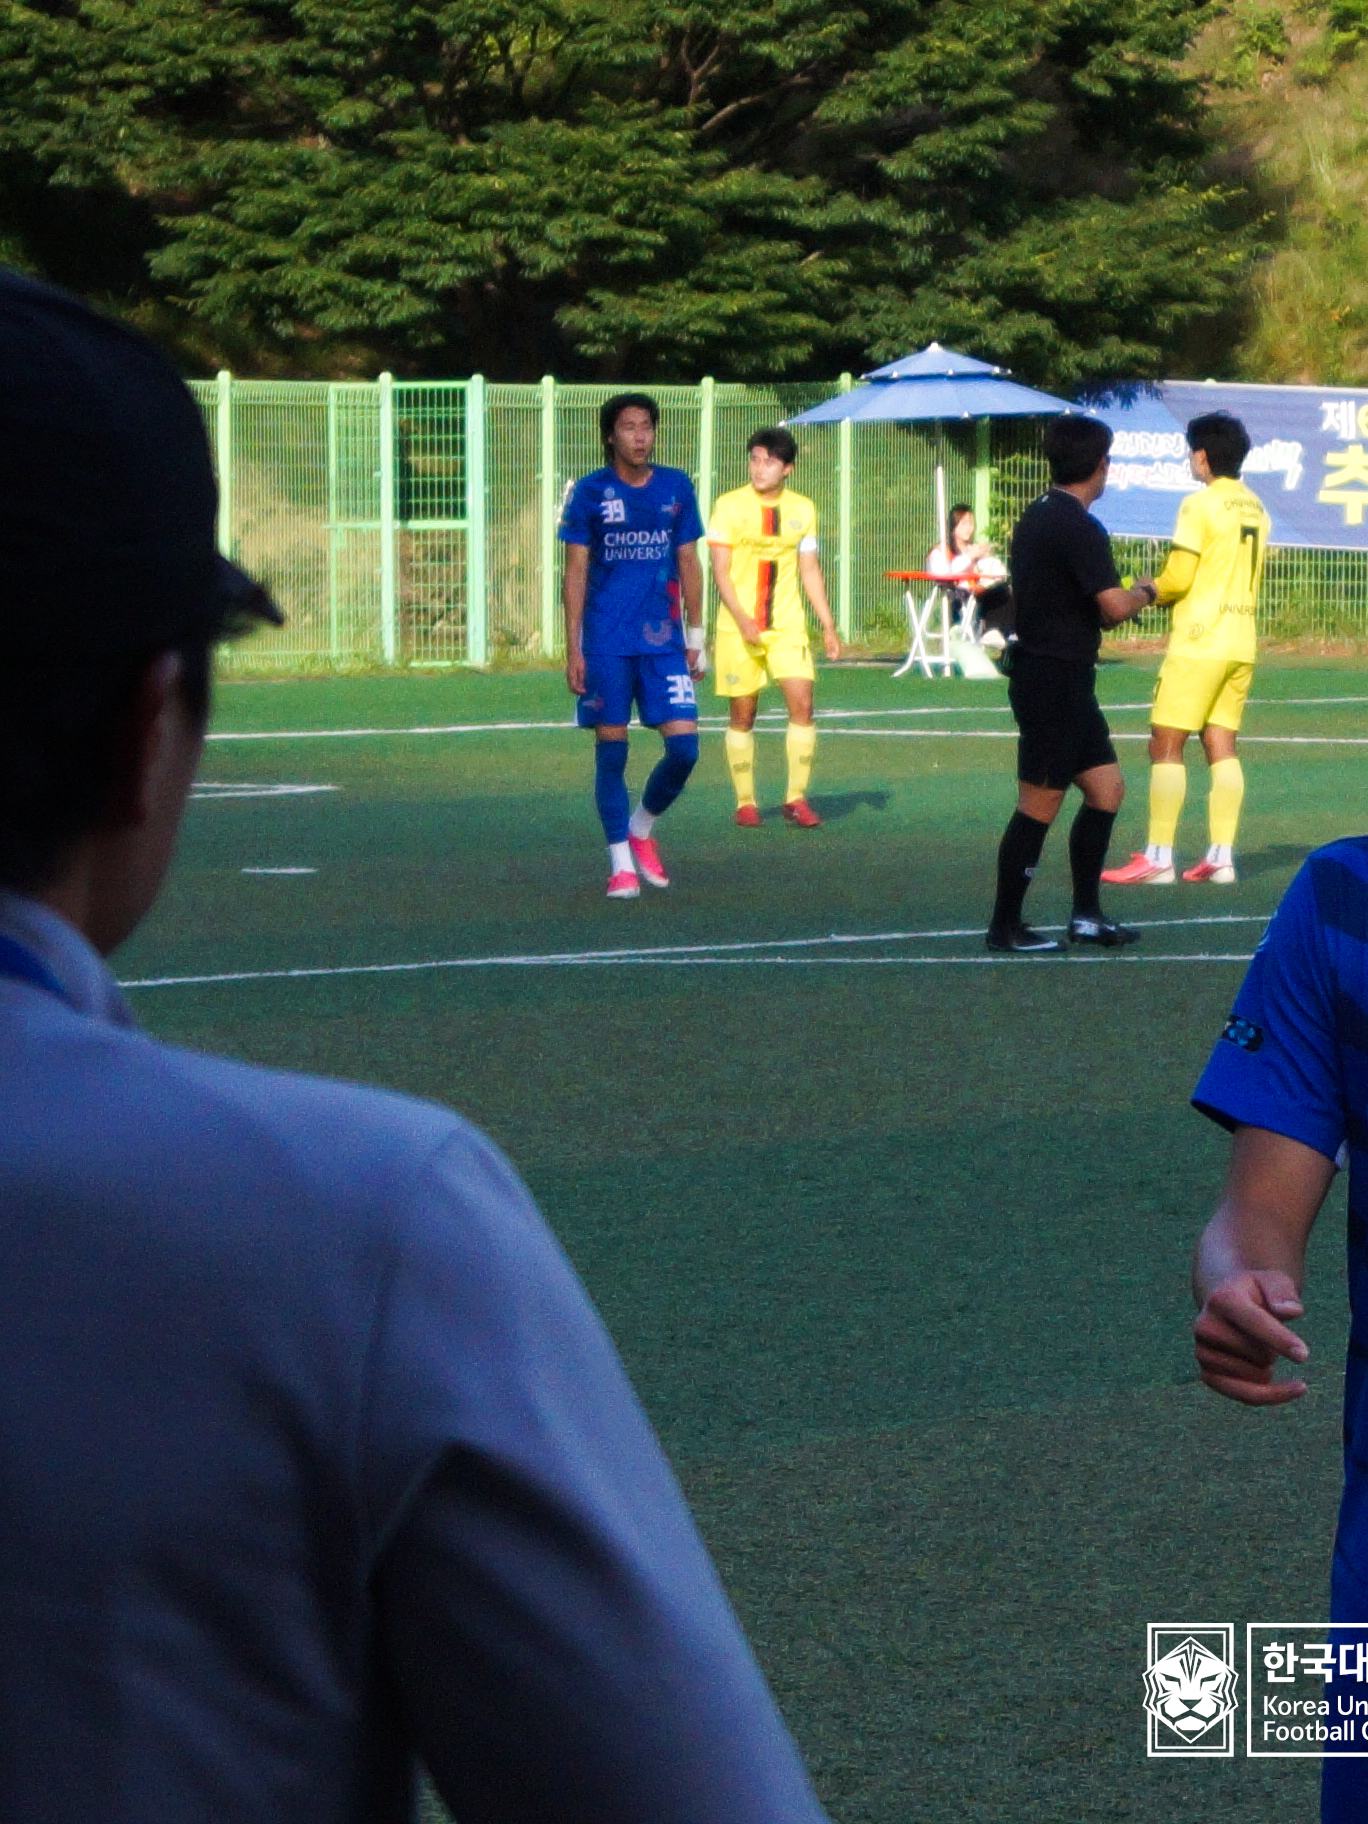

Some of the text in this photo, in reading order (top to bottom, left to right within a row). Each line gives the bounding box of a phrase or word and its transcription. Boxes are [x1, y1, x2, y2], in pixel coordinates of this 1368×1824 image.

[600, 498, 626, 524] 39
[1240, 523, 1260, 592] 7
[666, 674, 696, 704] 39
